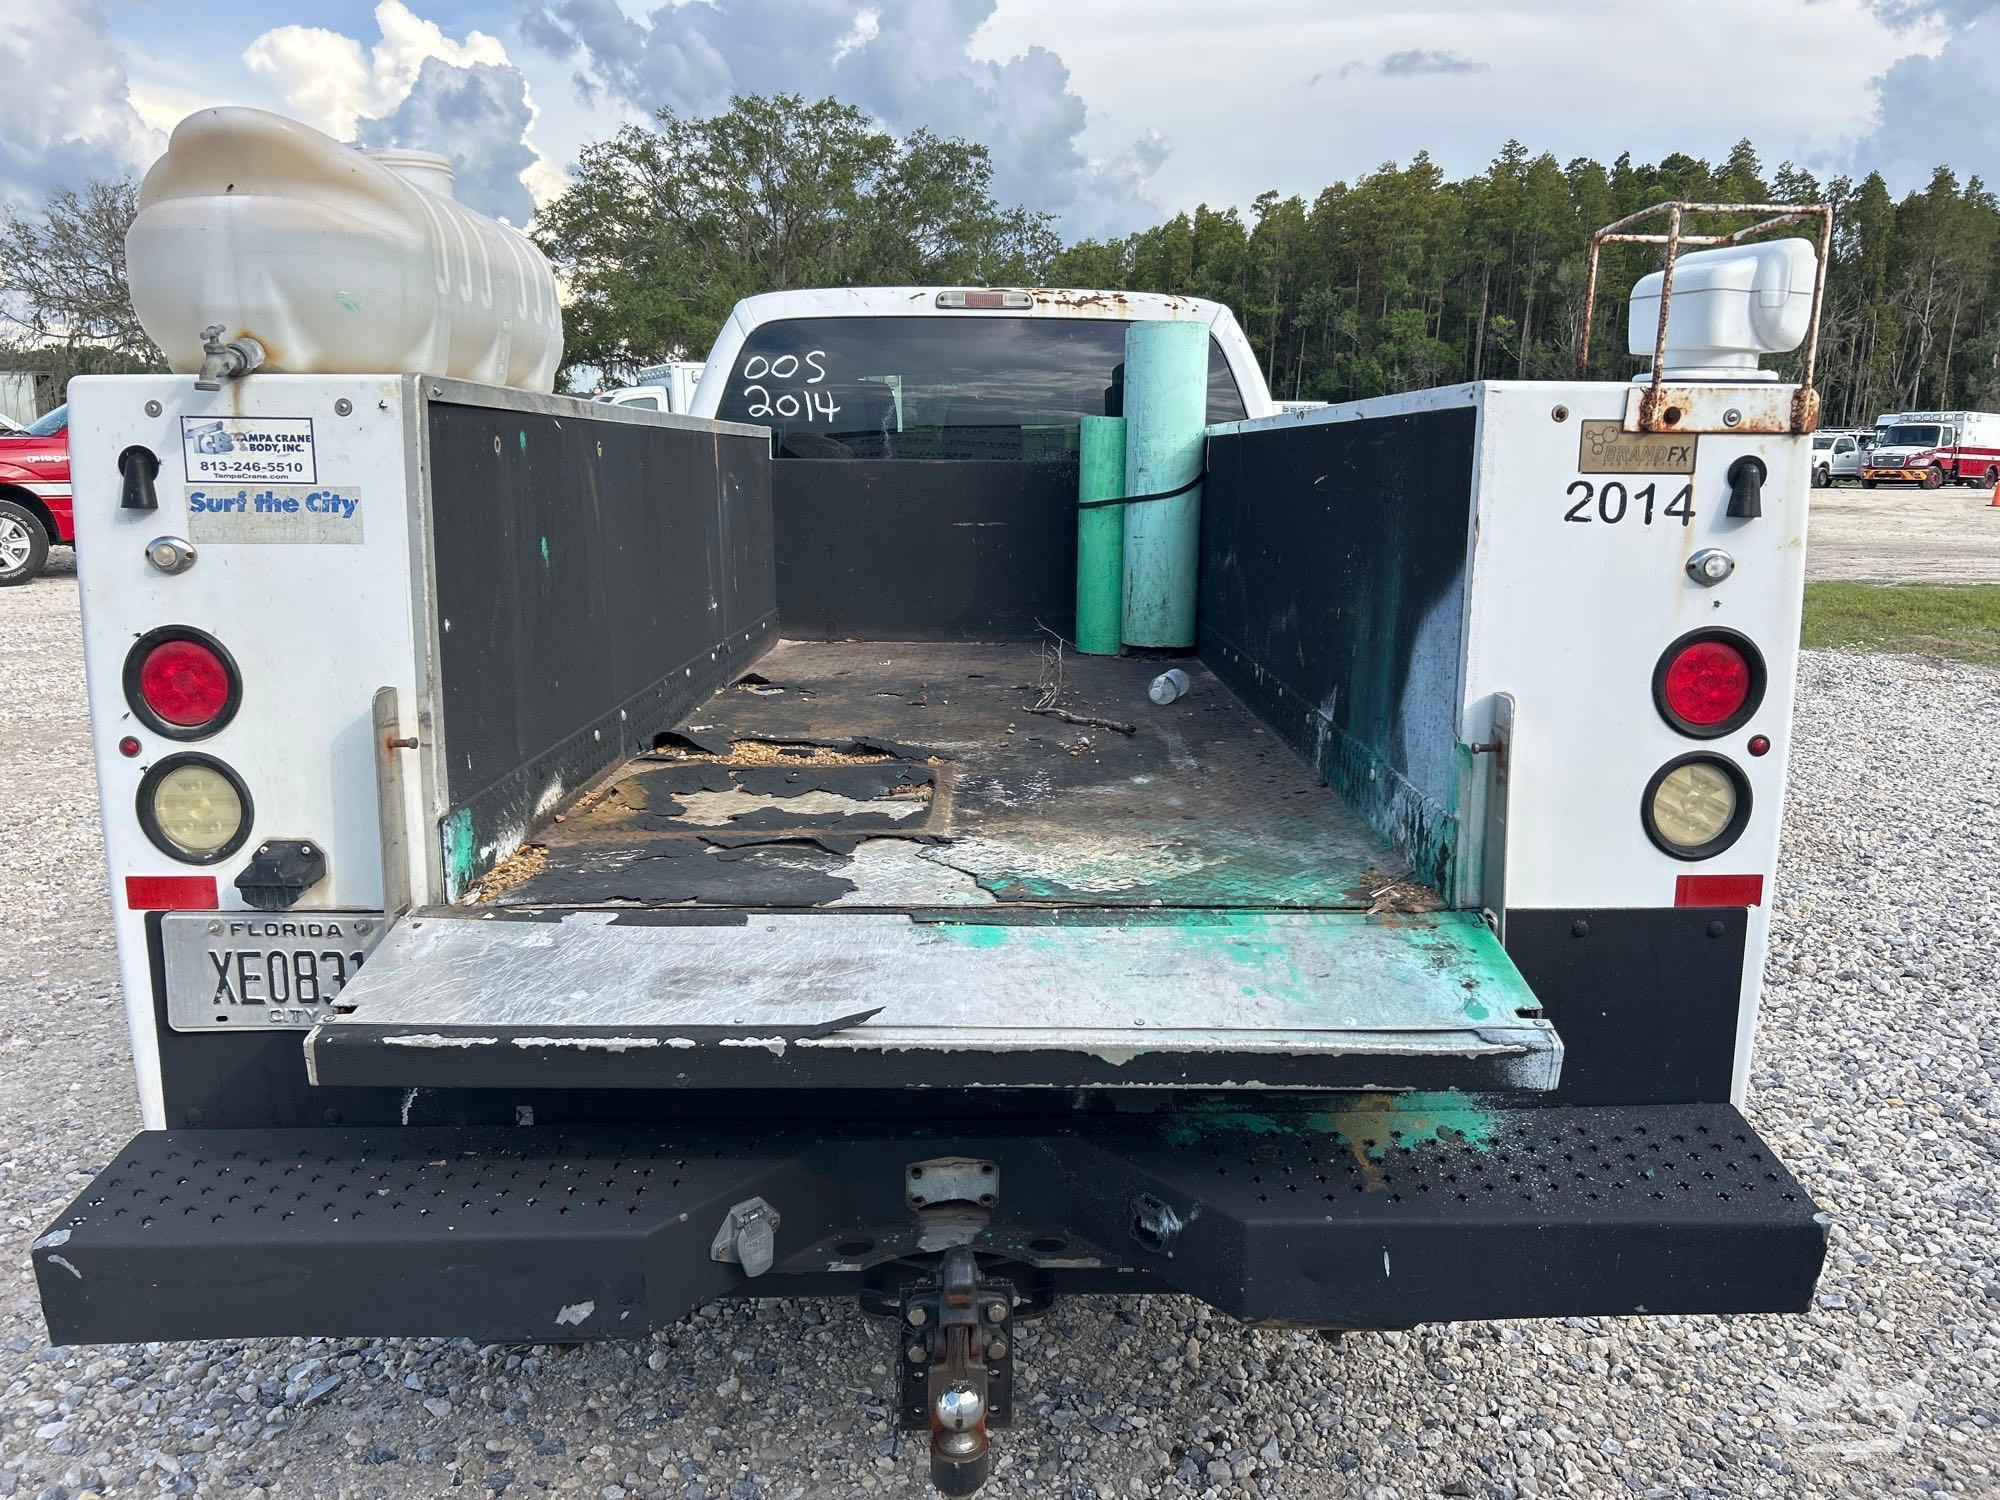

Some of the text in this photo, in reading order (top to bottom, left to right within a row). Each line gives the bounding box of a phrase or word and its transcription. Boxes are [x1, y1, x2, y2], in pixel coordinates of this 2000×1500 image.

[743, 385, 841, 424] 2014
[275, 434, 311, 443] CRANE
[240, 443, 305, 454] & BODY, INC.
[1603, 446, 1691, 462] BRANDFX
[200, 461, 303, 473] 813-246-5510
[190, 490, 359, 519] Surf the City
[1564, 480, 1696, 527] 2014
[230, 922, 343, 938] FLORIDA
[268, 1008, 319, 1023] CITY
